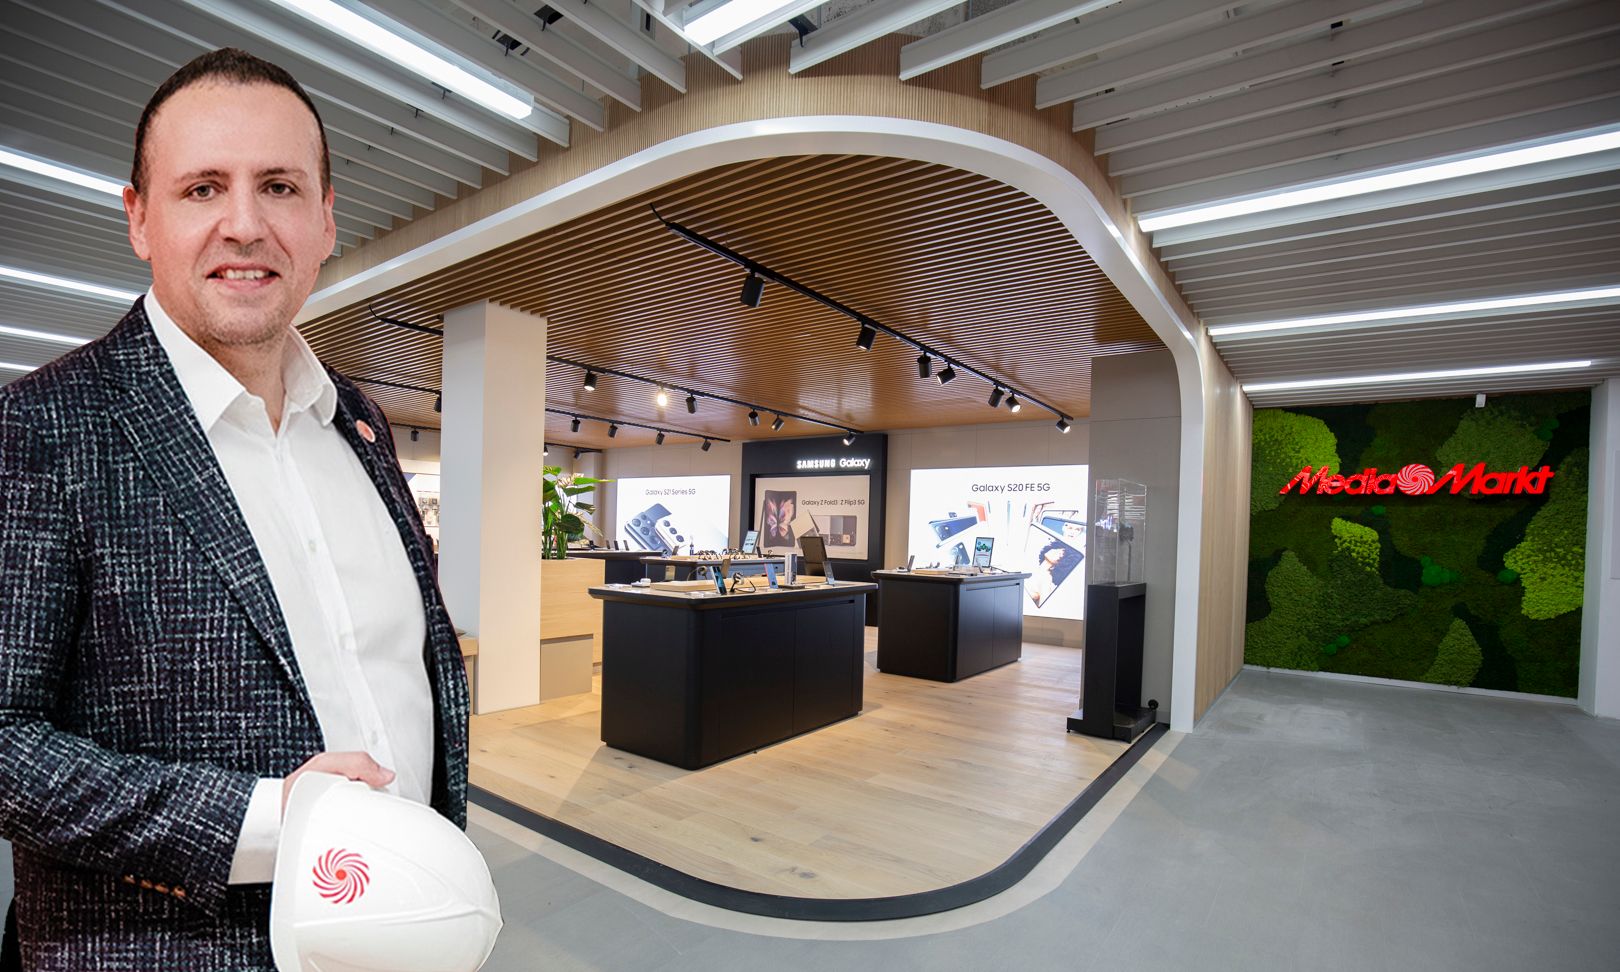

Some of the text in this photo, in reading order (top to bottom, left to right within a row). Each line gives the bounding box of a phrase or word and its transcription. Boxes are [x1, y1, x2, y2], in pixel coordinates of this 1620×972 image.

[797, 458, 870, 469] SAMSUNG Galaxy
[1279, 462, 1555, 495] Media Markt
[971, 483, 1050, 494] Galaxy S20 FE 5G
